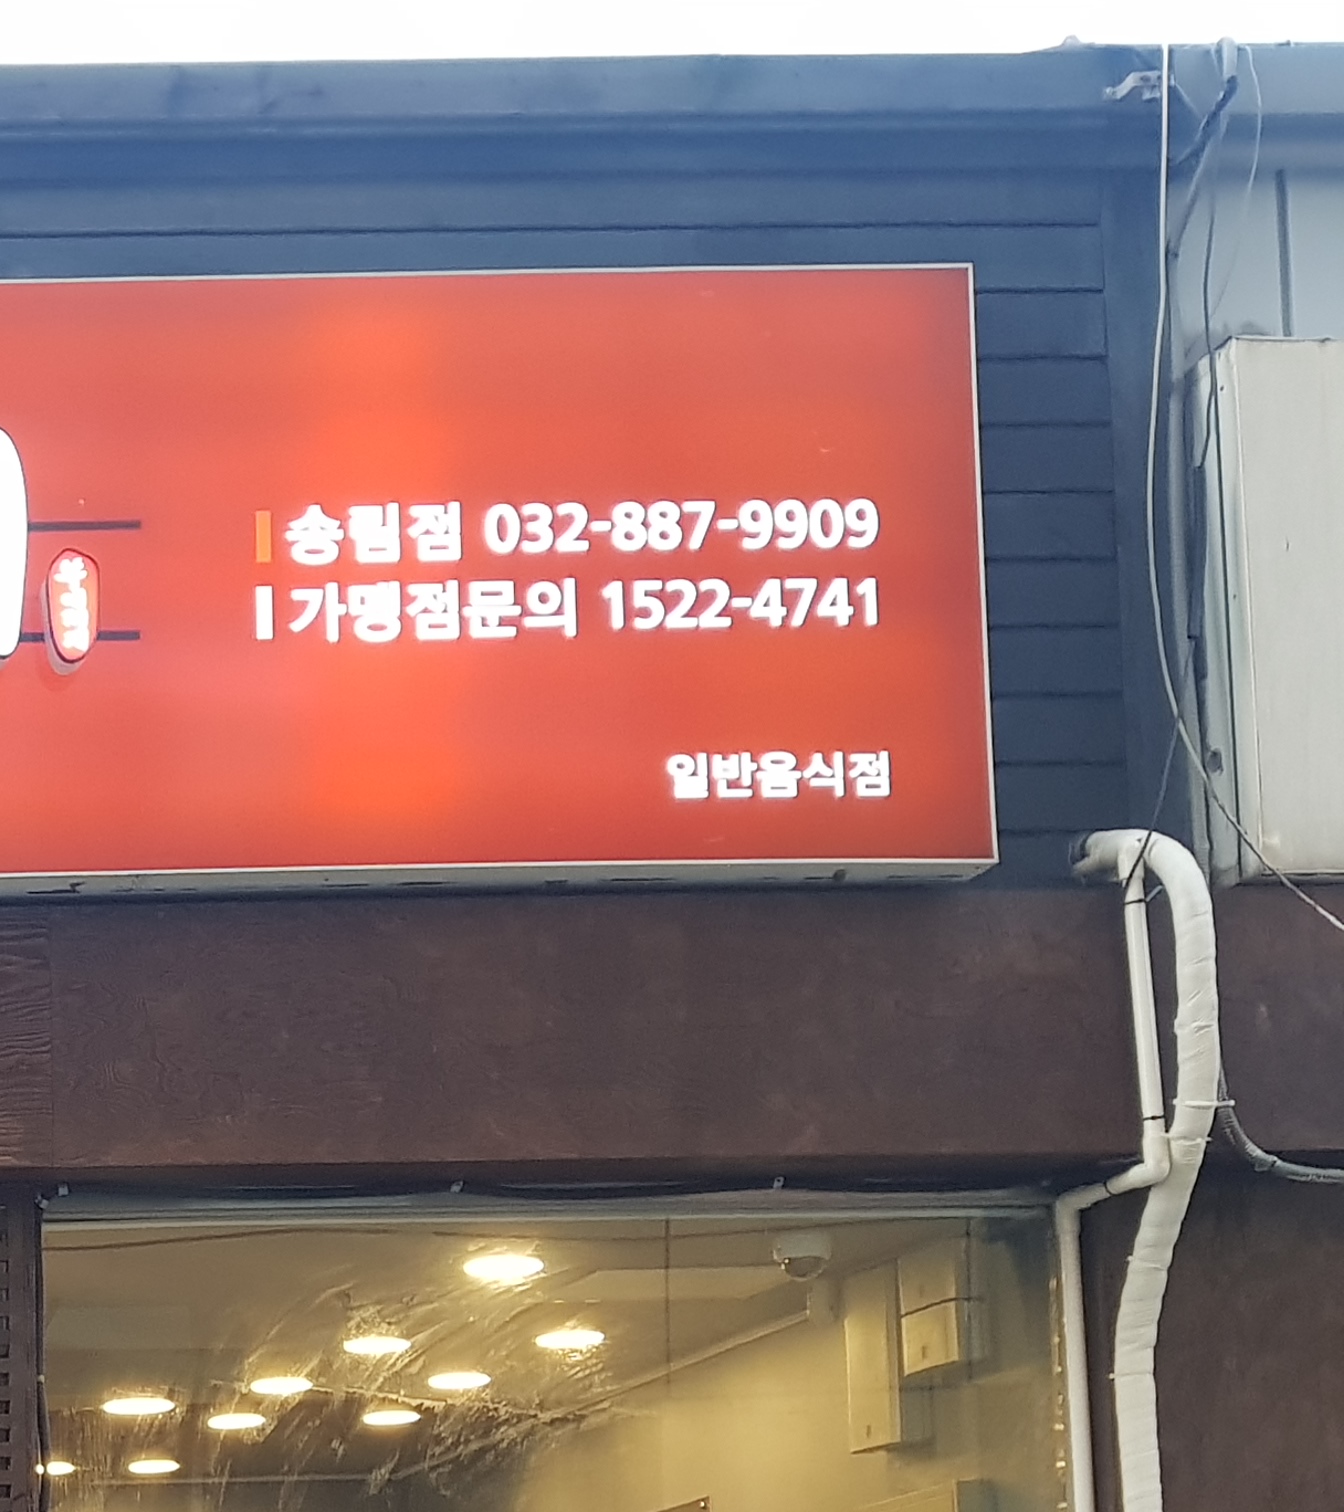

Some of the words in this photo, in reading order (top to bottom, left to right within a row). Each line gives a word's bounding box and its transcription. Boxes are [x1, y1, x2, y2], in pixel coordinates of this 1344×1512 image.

[284, 500, 464, 566] 송림점
[483, 498, 880, 554] 032-887-9909
[288, 577, 579, 643] 가맹점문의
[601, 576, 880, 630] 1522-4741
[665, 750, 892, 800] 일반음식점
